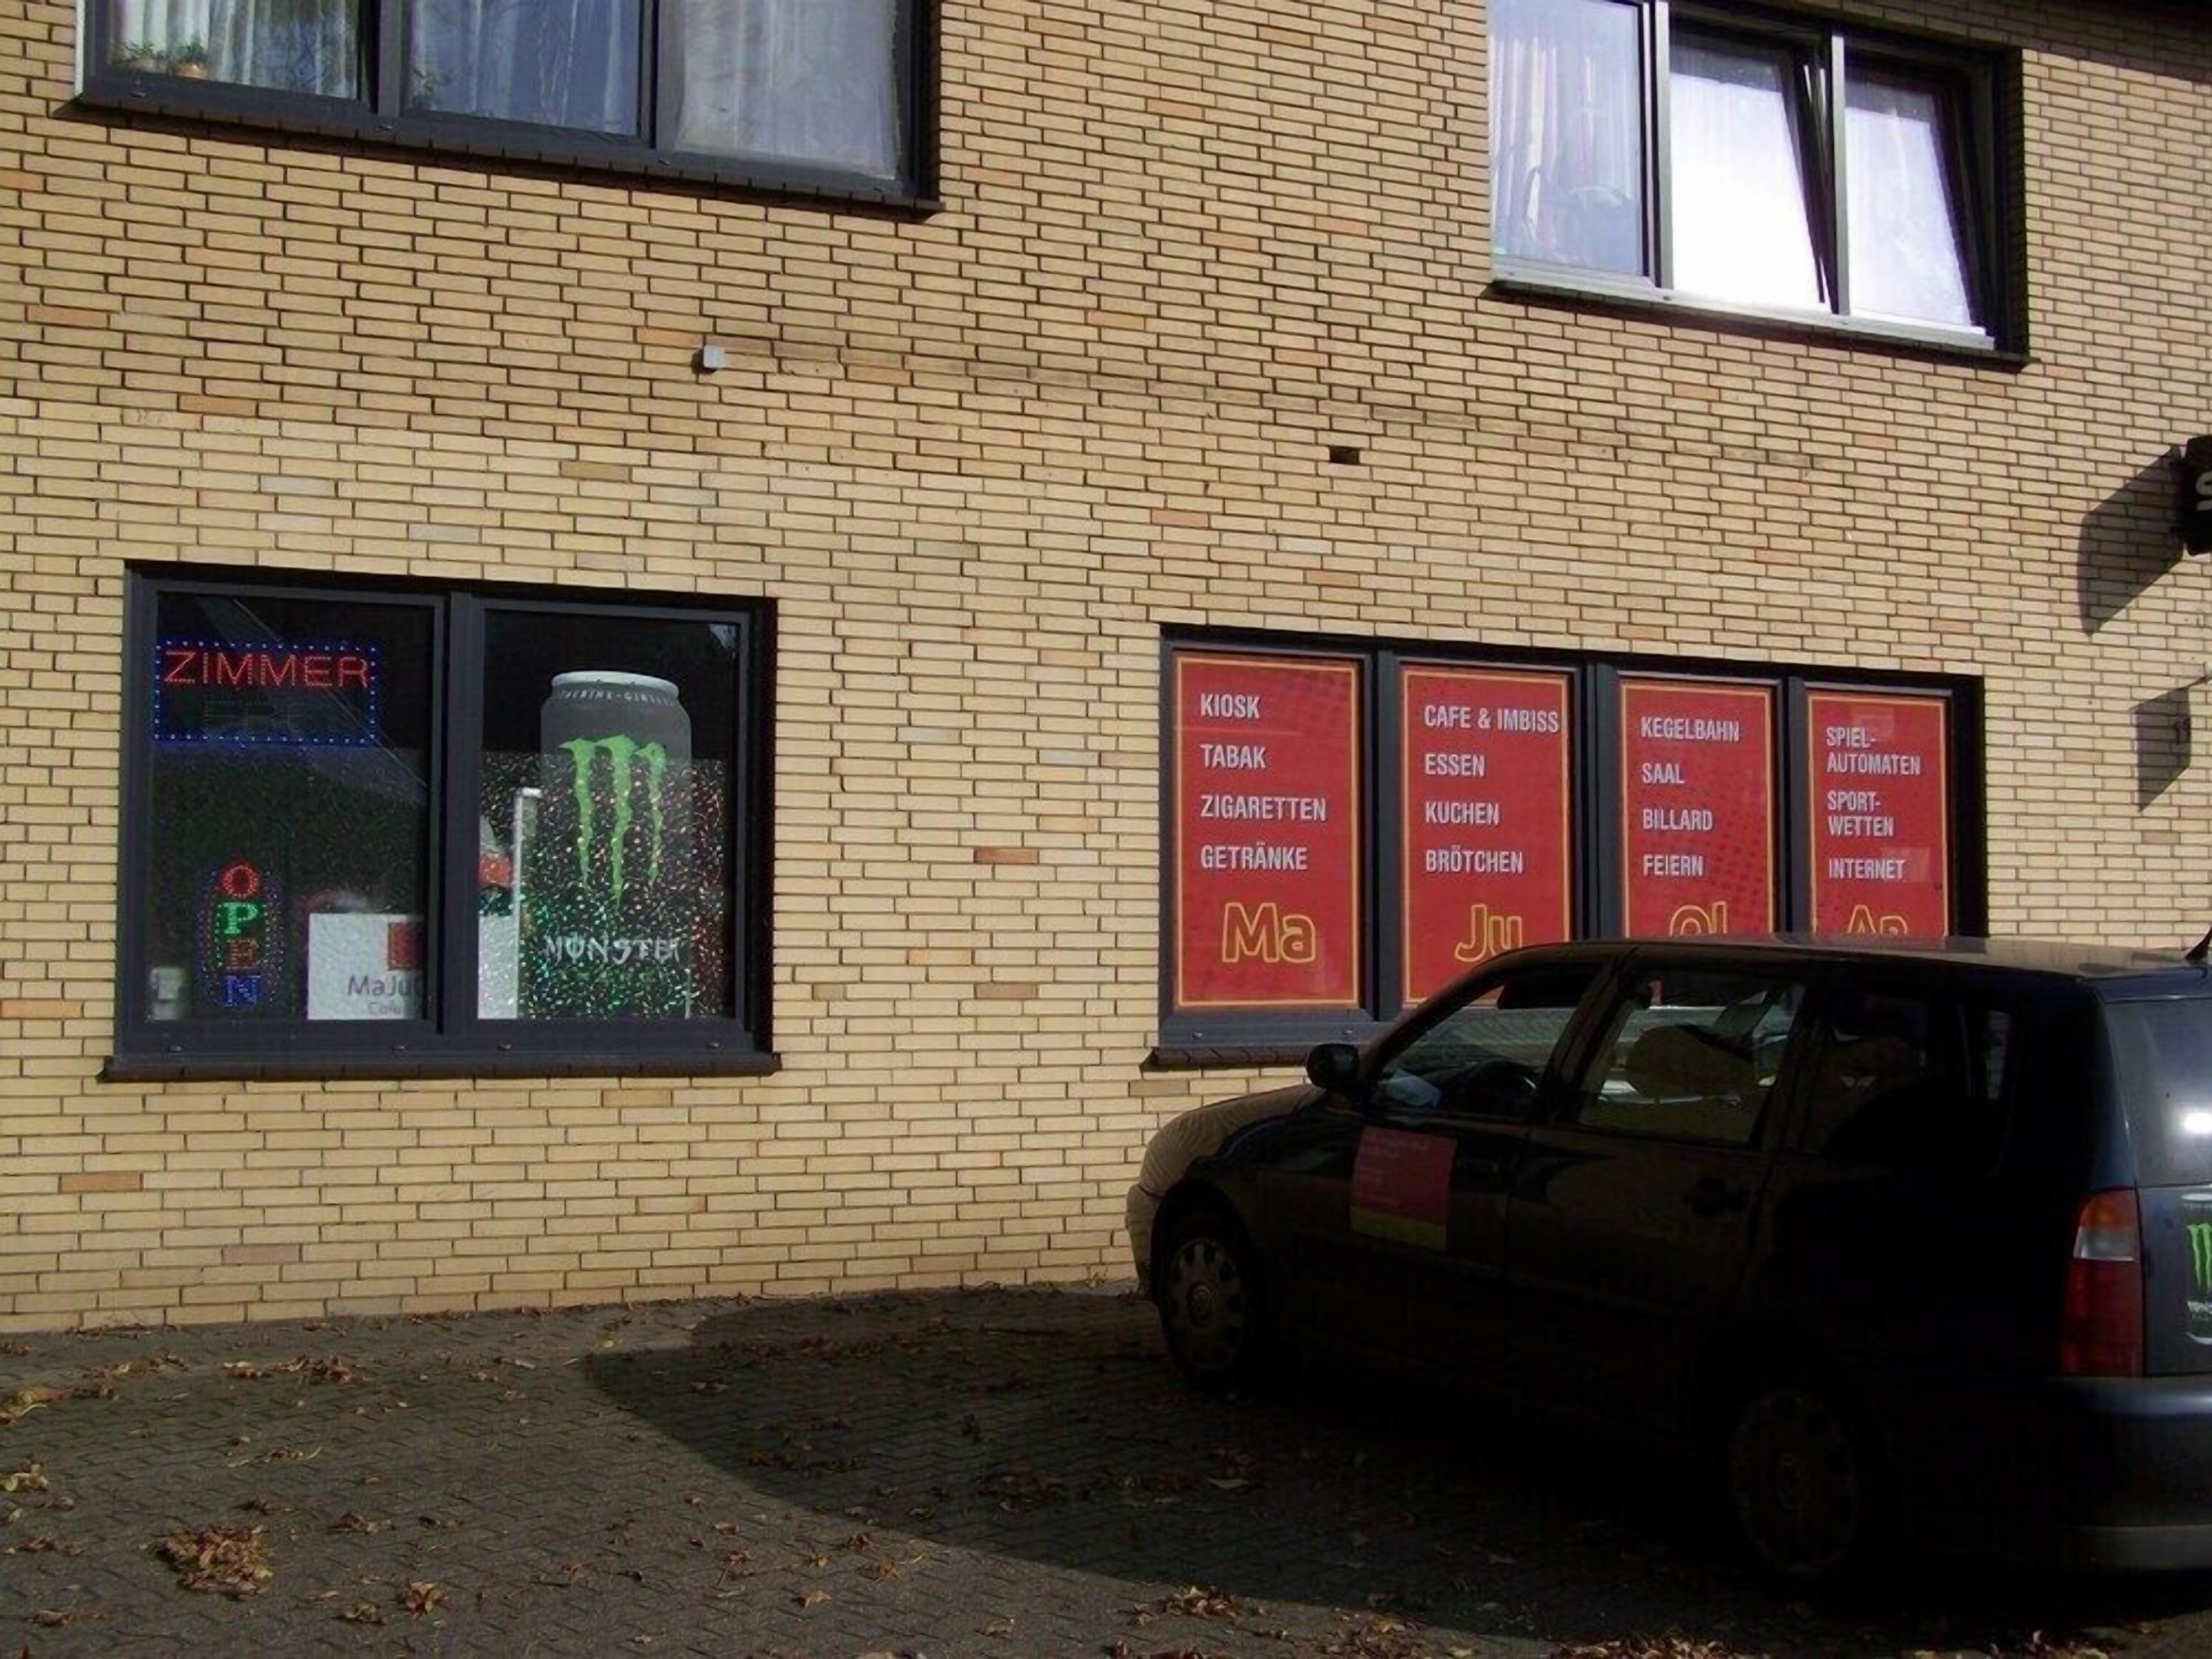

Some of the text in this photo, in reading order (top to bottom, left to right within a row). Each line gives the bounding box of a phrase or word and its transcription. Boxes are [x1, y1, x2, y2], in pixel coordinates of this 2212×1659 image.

[164, 651, 368, 688] ZIMMER
[1200, 693, 1260, 719] KIOSK
[1424, 705, 1560, 733] CAFE & IMBISS
[1640, 716, 1740, 742] KEGELBAHN
[1825, 726, 1876, 749] SPIEL-
[1200, 744, 1266, 769] TABAK
[1424, 753, 1485, 778] ESSEN
[1827, 752, 1921, 775] AUTOMATEN
[1641, 762, 1685, 785] SAAL
[1200, 794, 1327, 822] ZIGARETTEN
[1827, 789, 1881, 812] SPORT-
[1425, 801, 1500, 826] KUCHEN
[1642, 807, 1713, 831] BILLARD
[1827, 815, 1894, 837] WETTEN
[1200, 841, 1308, 870] GETRÄNKE
[1425, 844, 1524, 874] BRÖTCHEN
[1642, 854, 1704, 877] FEIERN
[1828, 858, 1906, 880] INTERNET
[222, 864, 260, 1008] OPEN
[1222, 902, 1317, 963] Ma
[1454, 902, 1522, 963] Ju
